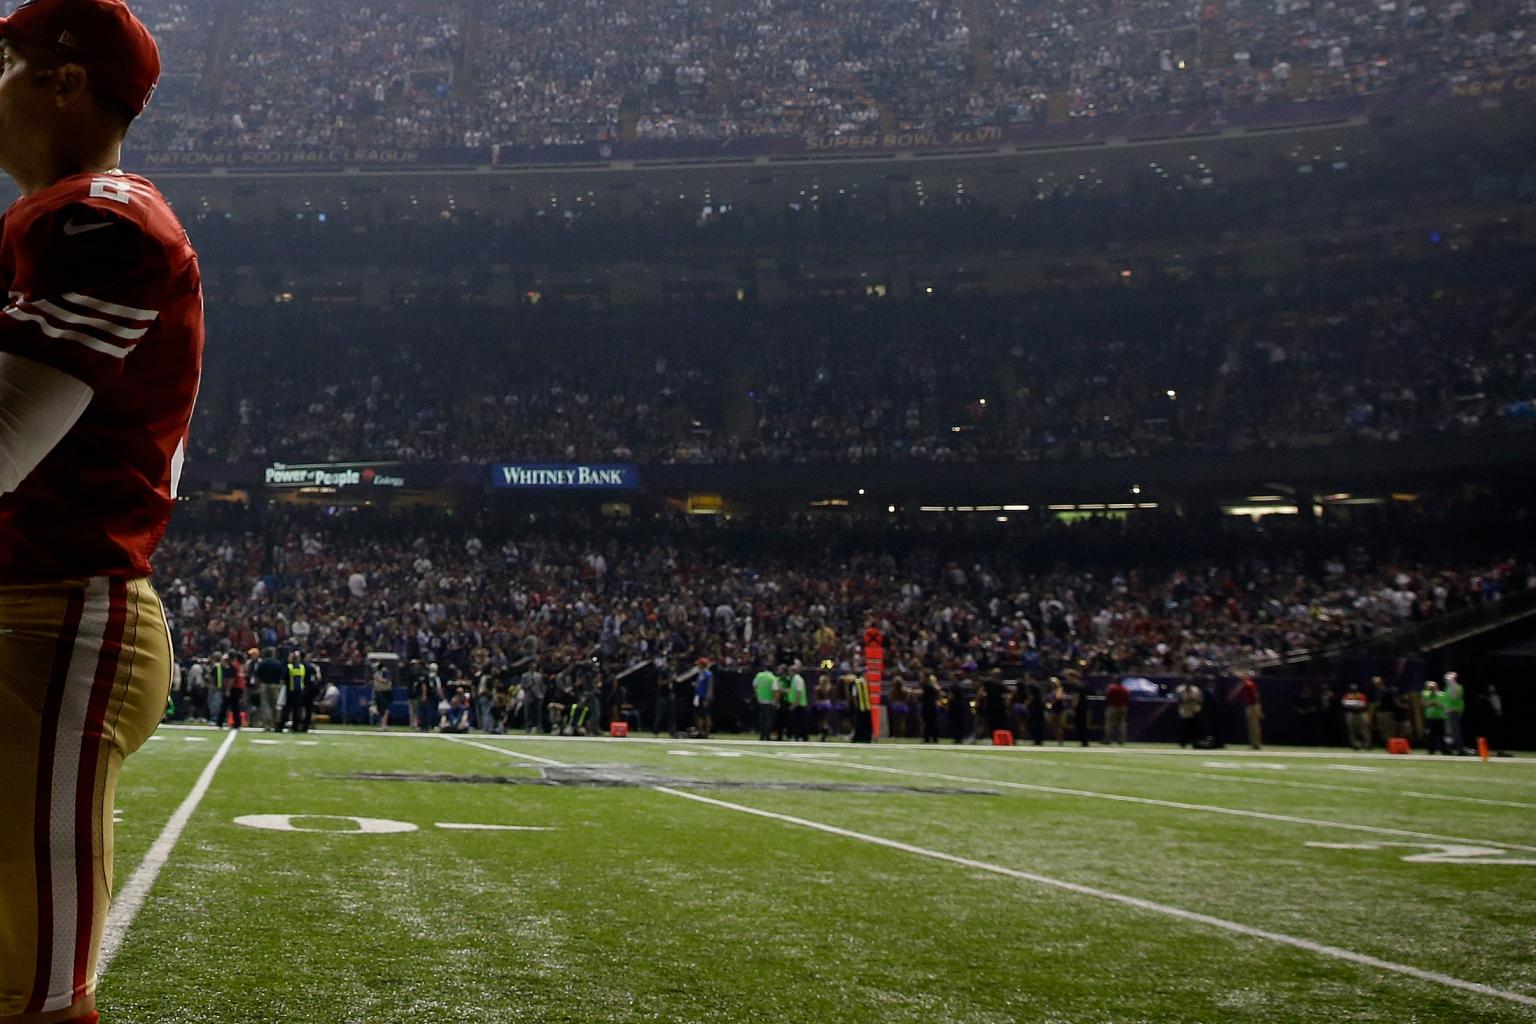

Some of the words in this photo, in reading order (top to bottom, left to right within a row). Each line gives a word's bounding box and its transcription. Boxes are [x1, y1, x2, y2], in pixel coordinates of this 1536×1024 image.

[805, 134, 877, 150] SUPER
[882, 132, 944, 147] BOWL
[949, 127, 1003, 145] XLVII
[144, 150, 234, 164] NATIONAL
[241, 150, 336, 164] FOOTBALL
[343, 149, 418, 163] LEAGUE
[265, 467, 308, 484] Power
[314, 469, 361, 488] People
[502, 466, 577, 485] WHITNEY
[577, 466, 623, 485] BANK
